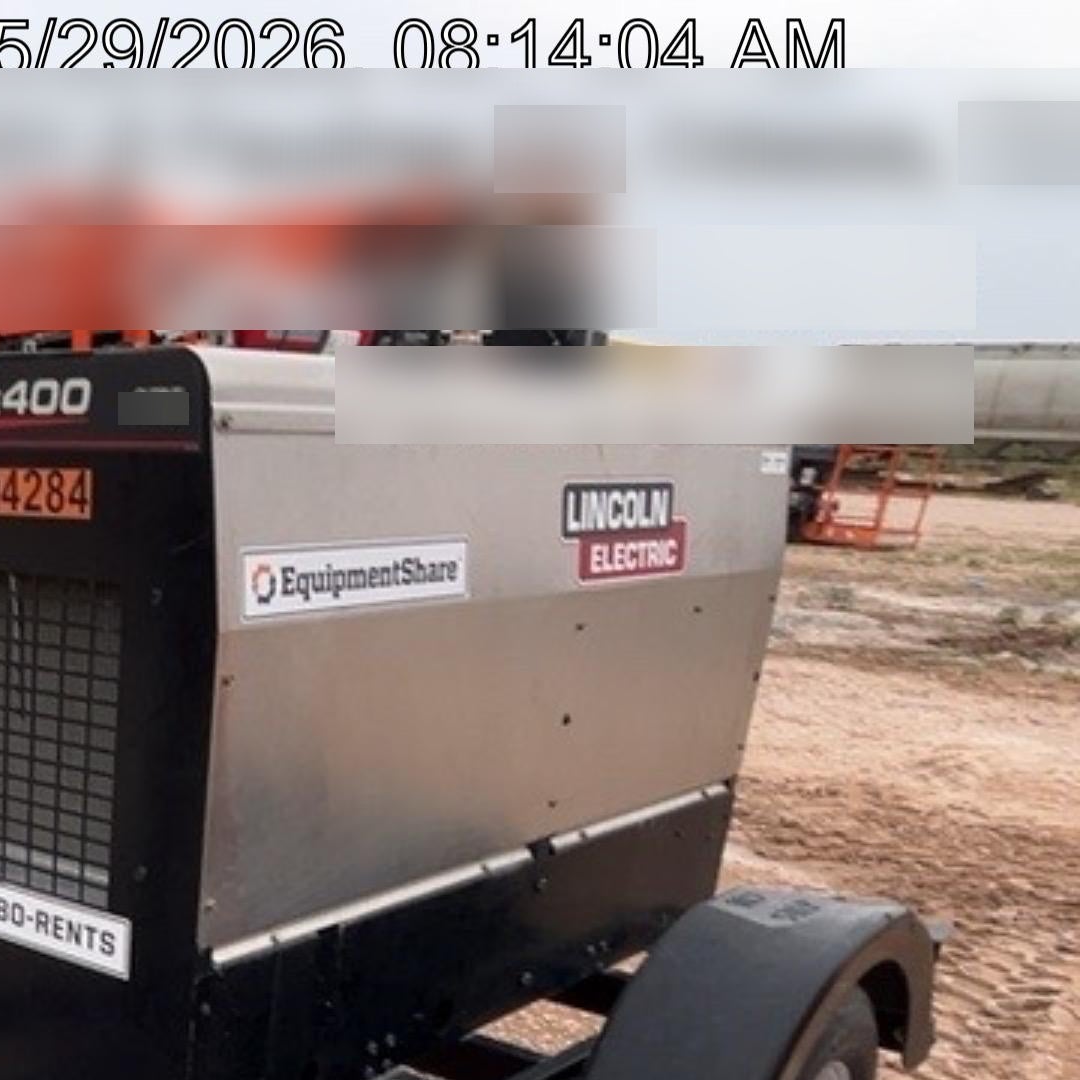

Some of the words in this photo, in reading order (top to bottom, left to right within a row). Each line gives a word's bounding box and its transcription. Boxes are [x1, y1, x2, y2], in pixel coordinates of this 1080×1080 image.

[566, 487, 670, 532] LINCOLN
[590, 539, 678, 574] ELECTRIC
[280, 557, 457, 601] EquipmentShare
